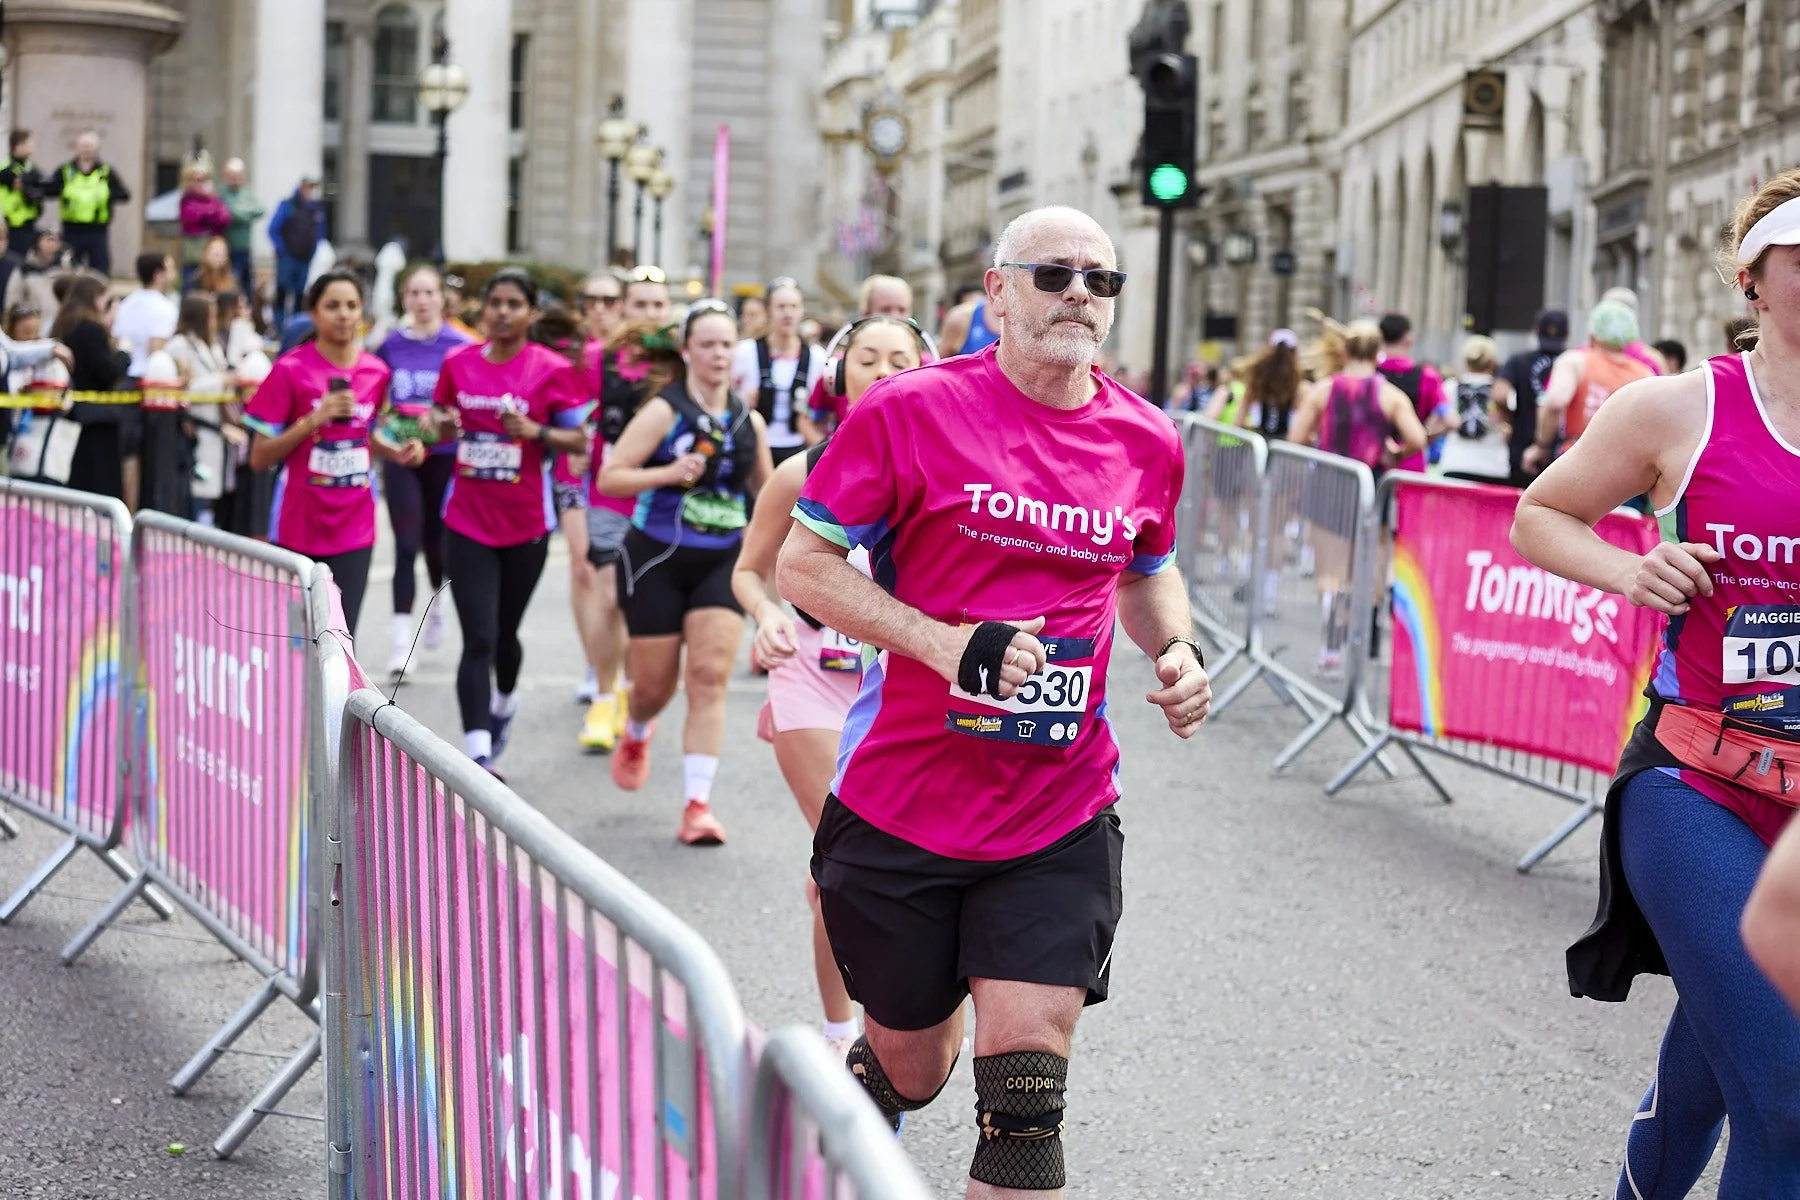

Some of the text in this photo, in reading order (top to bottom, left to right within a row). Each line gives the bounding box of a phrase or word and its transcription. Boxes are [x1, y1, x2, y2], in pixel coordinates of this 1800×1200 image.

[963, 483, 1137, 546] Tommy's
[957, 524, 977, 539] The
[981, 532, 1043, 553] pregnancy
[1046, 544, 1068, 557] and
[1070, 546, 1099, 563] baby
[1465, 550, 1619, 645] Tommys
[1713, 572, 1800, 593] The pregnanc
[1744, 612, 1800, 625] MAGGIE
[970, 670, 1084, 707] 530
[1006, 1076, 1054, 1093] copper
